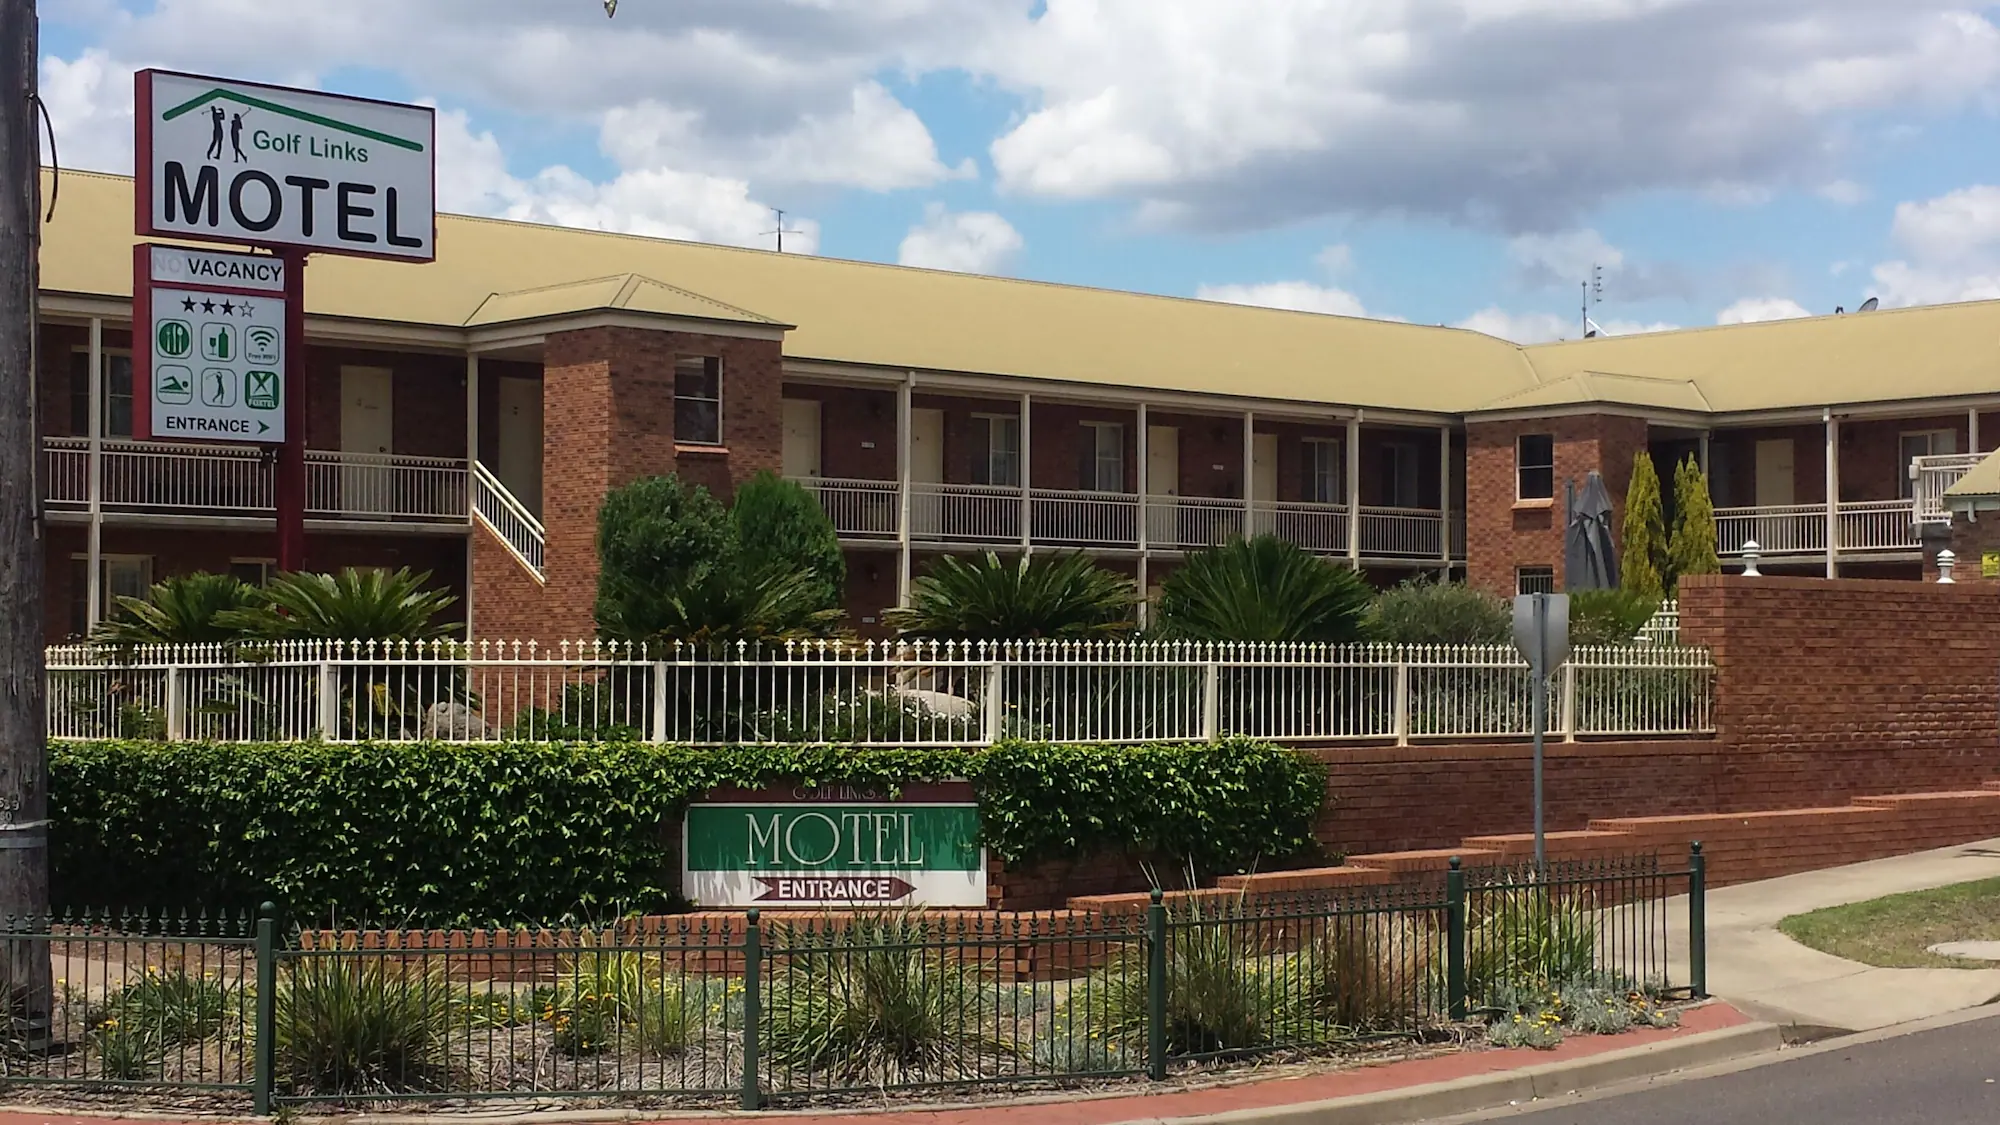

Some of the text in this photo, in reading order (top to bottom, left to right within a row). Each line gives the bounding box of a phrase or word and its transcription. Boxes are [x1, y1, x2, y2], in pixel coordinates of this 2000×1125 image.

[253, 130, 369, 163] Golf Links
[164, 161, 422, 248] MOTEL
[188, 258, 282, 282] VACANCY
[166, 416, 250, 433] ENTRANCE
[745, 810, 924, 867] MOTEL
[778, 879, 891, 899] ENTRANCE
